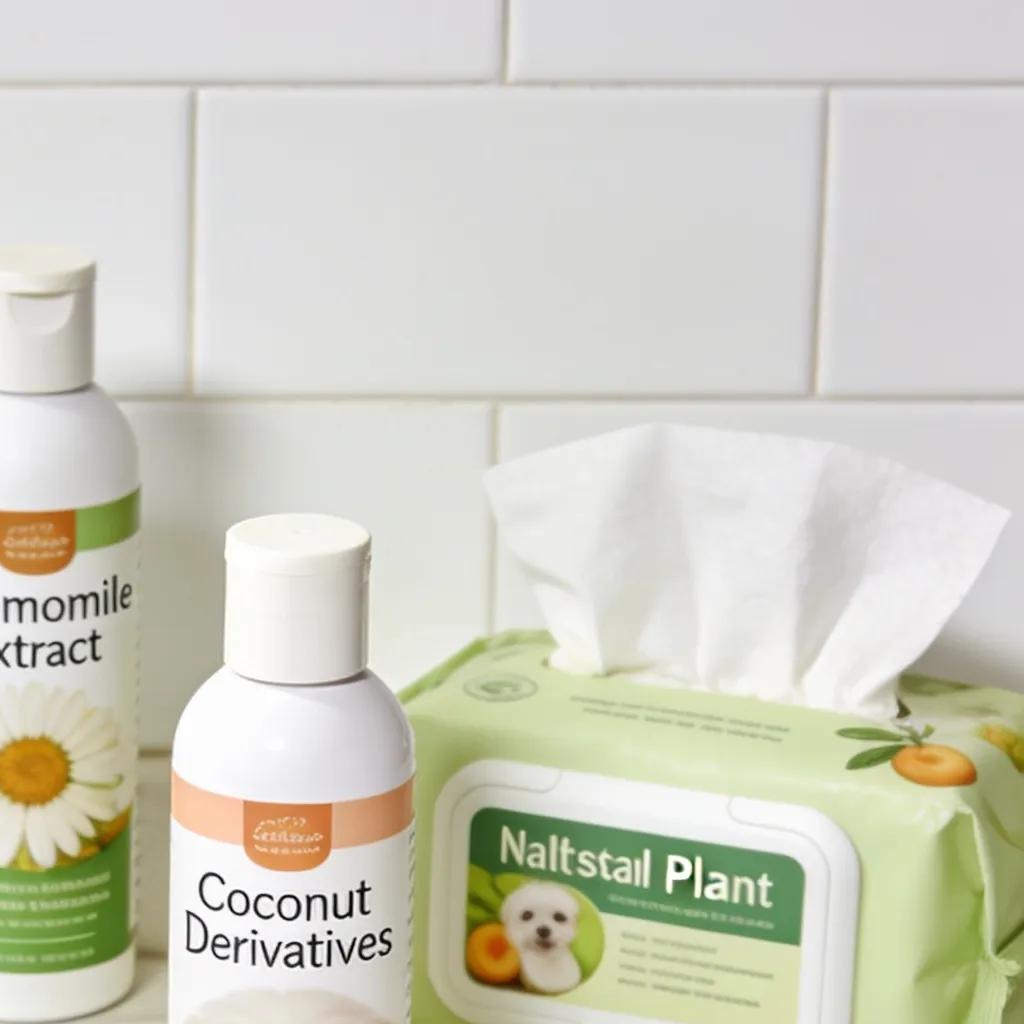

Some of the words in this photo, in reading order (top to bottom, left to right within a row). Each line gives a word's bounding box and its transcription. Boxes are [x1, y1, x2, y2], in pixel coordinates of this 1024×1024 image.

[198, 871, 372, 922] Coconut
[664, 853, 775, 909] Plant
[185, 909, 393, 969] Derivatives
